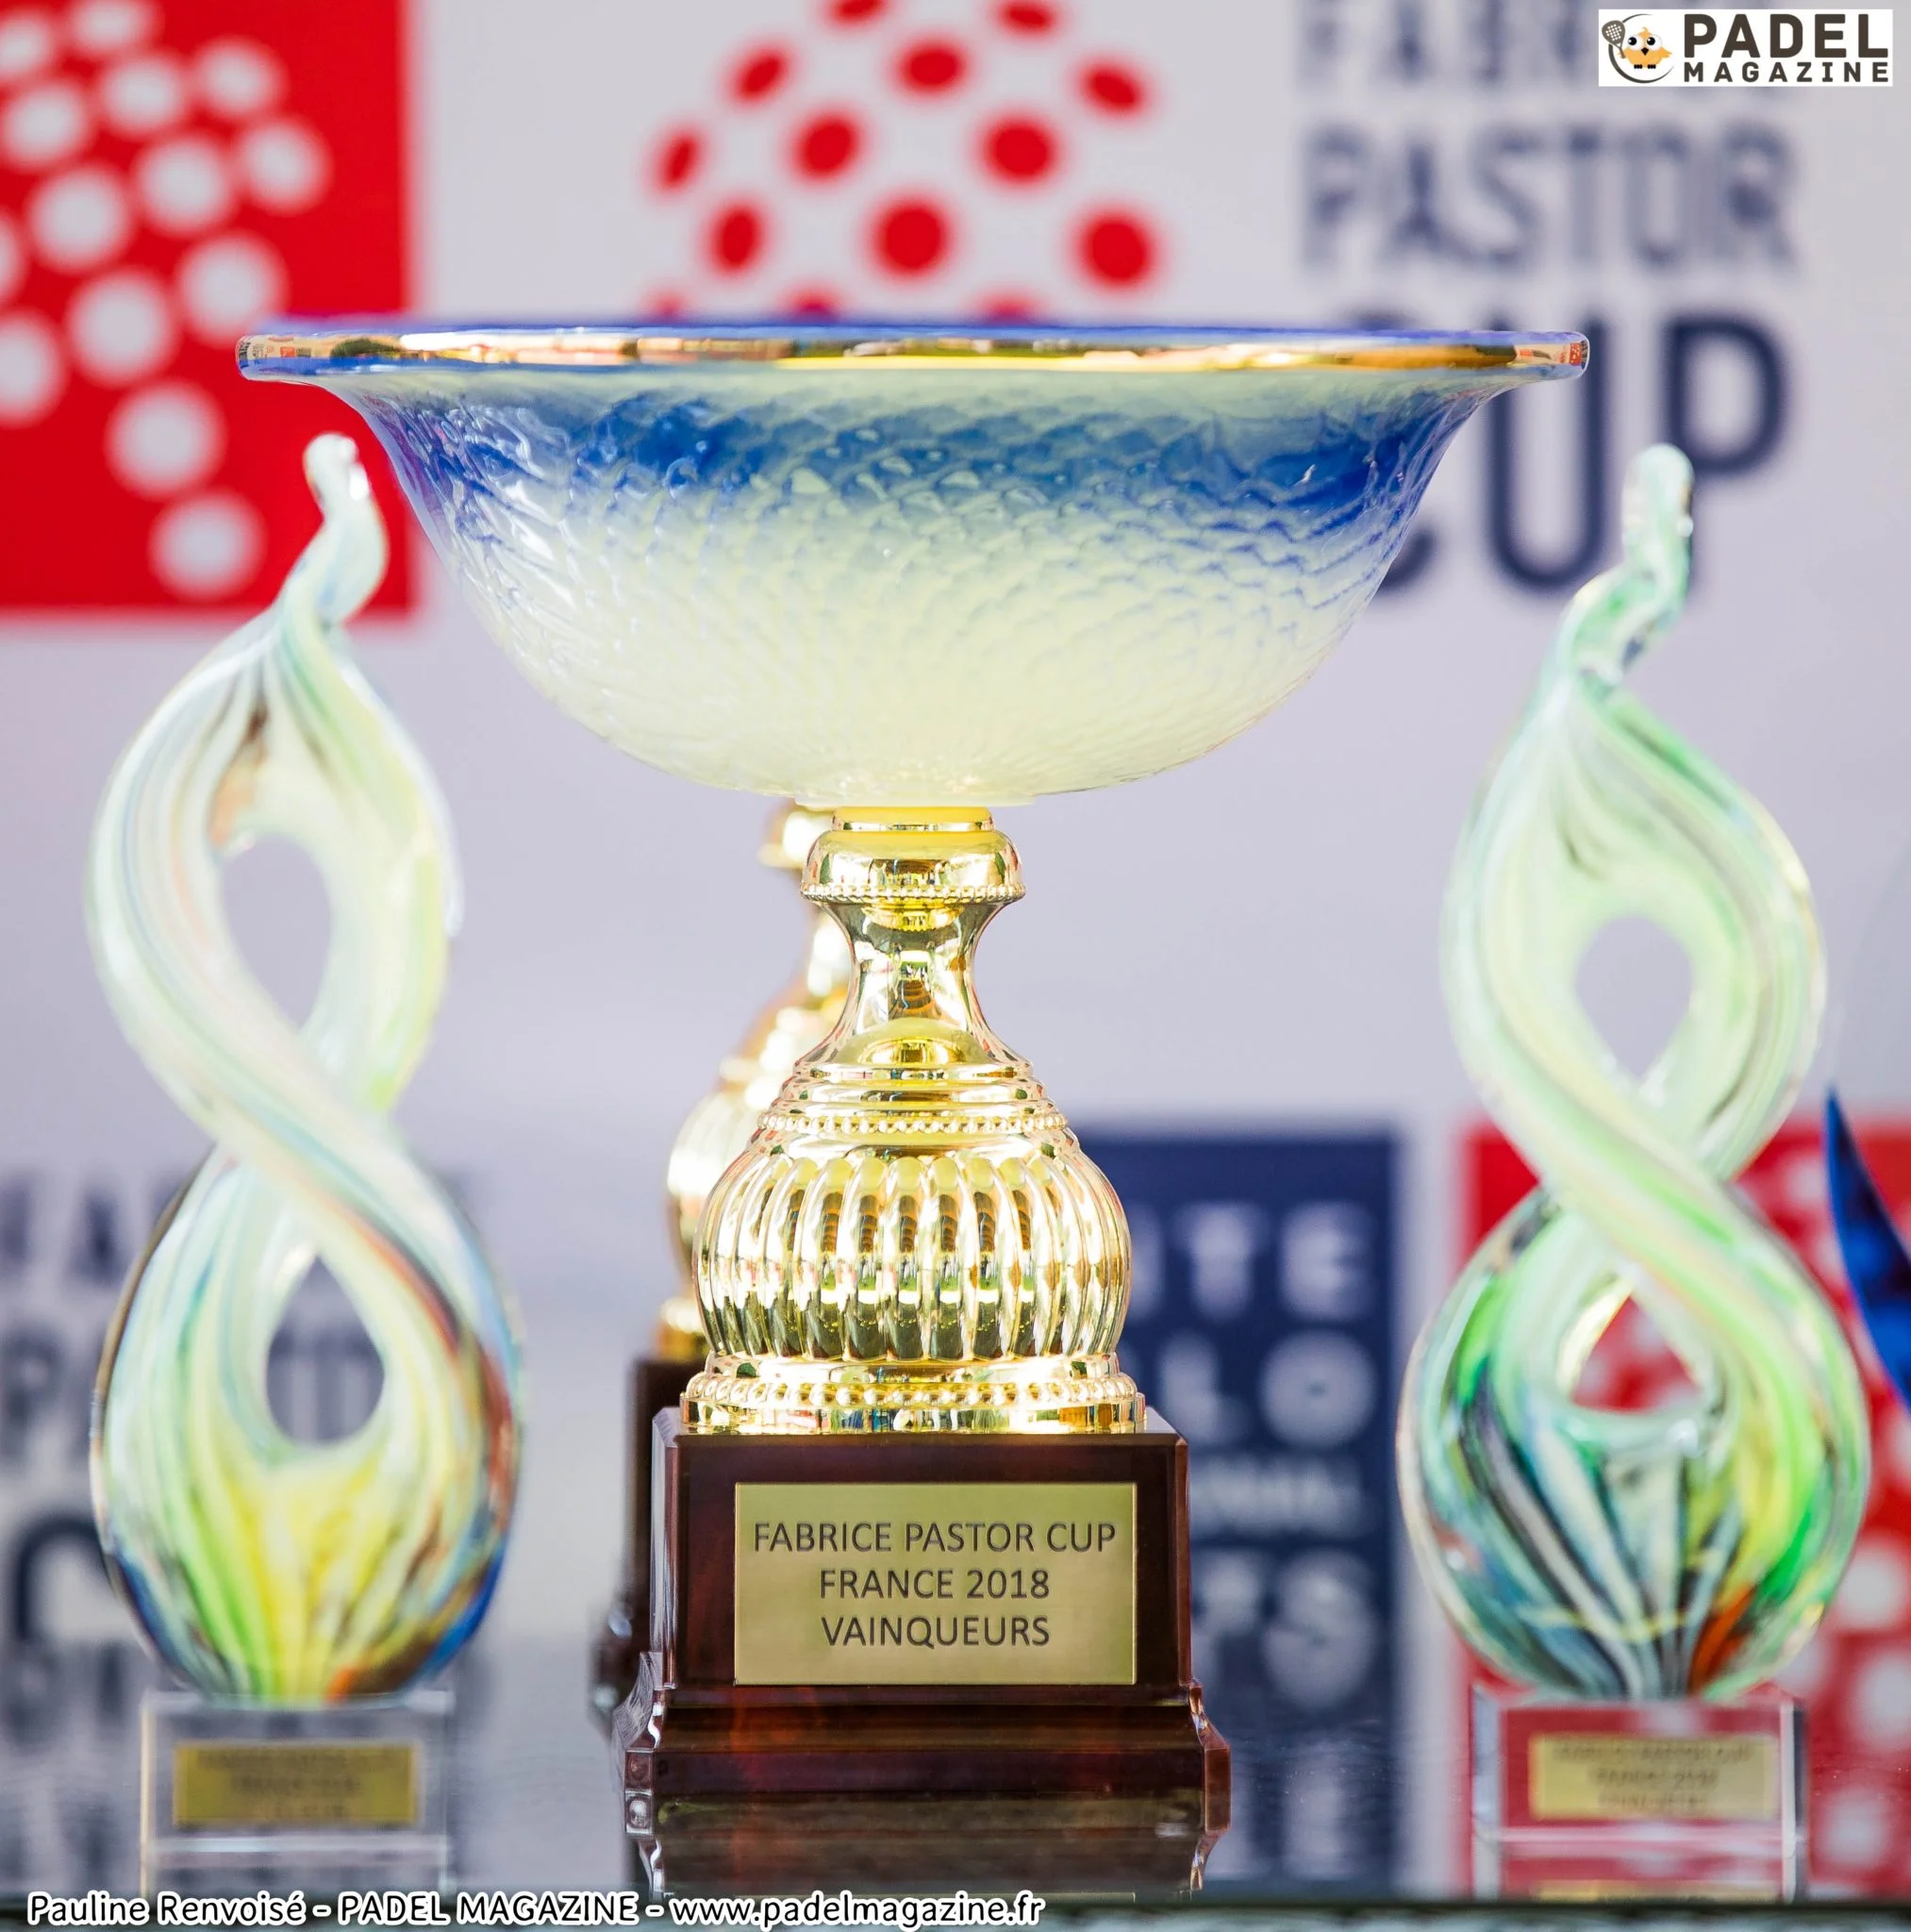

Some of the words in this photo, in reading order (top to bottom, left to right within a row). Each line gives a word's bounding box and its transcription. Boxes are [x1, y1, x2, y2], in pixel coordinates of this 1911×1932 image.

[1302, 121, 1795, 272] PASTOR
[1341, 309, 1786, 604] UP
[754, 1522, 891, 1553] FABRICE
[905, 1522, 1035, 1553] PASTOR
[1045, 1522, 1117, 1553] CUP
[820, 1569, 954, 1599] FRANCE
[966, 1569, 1050, 1599] 2018
[821, 1616, 1050, 1649] VAINQUEURS
